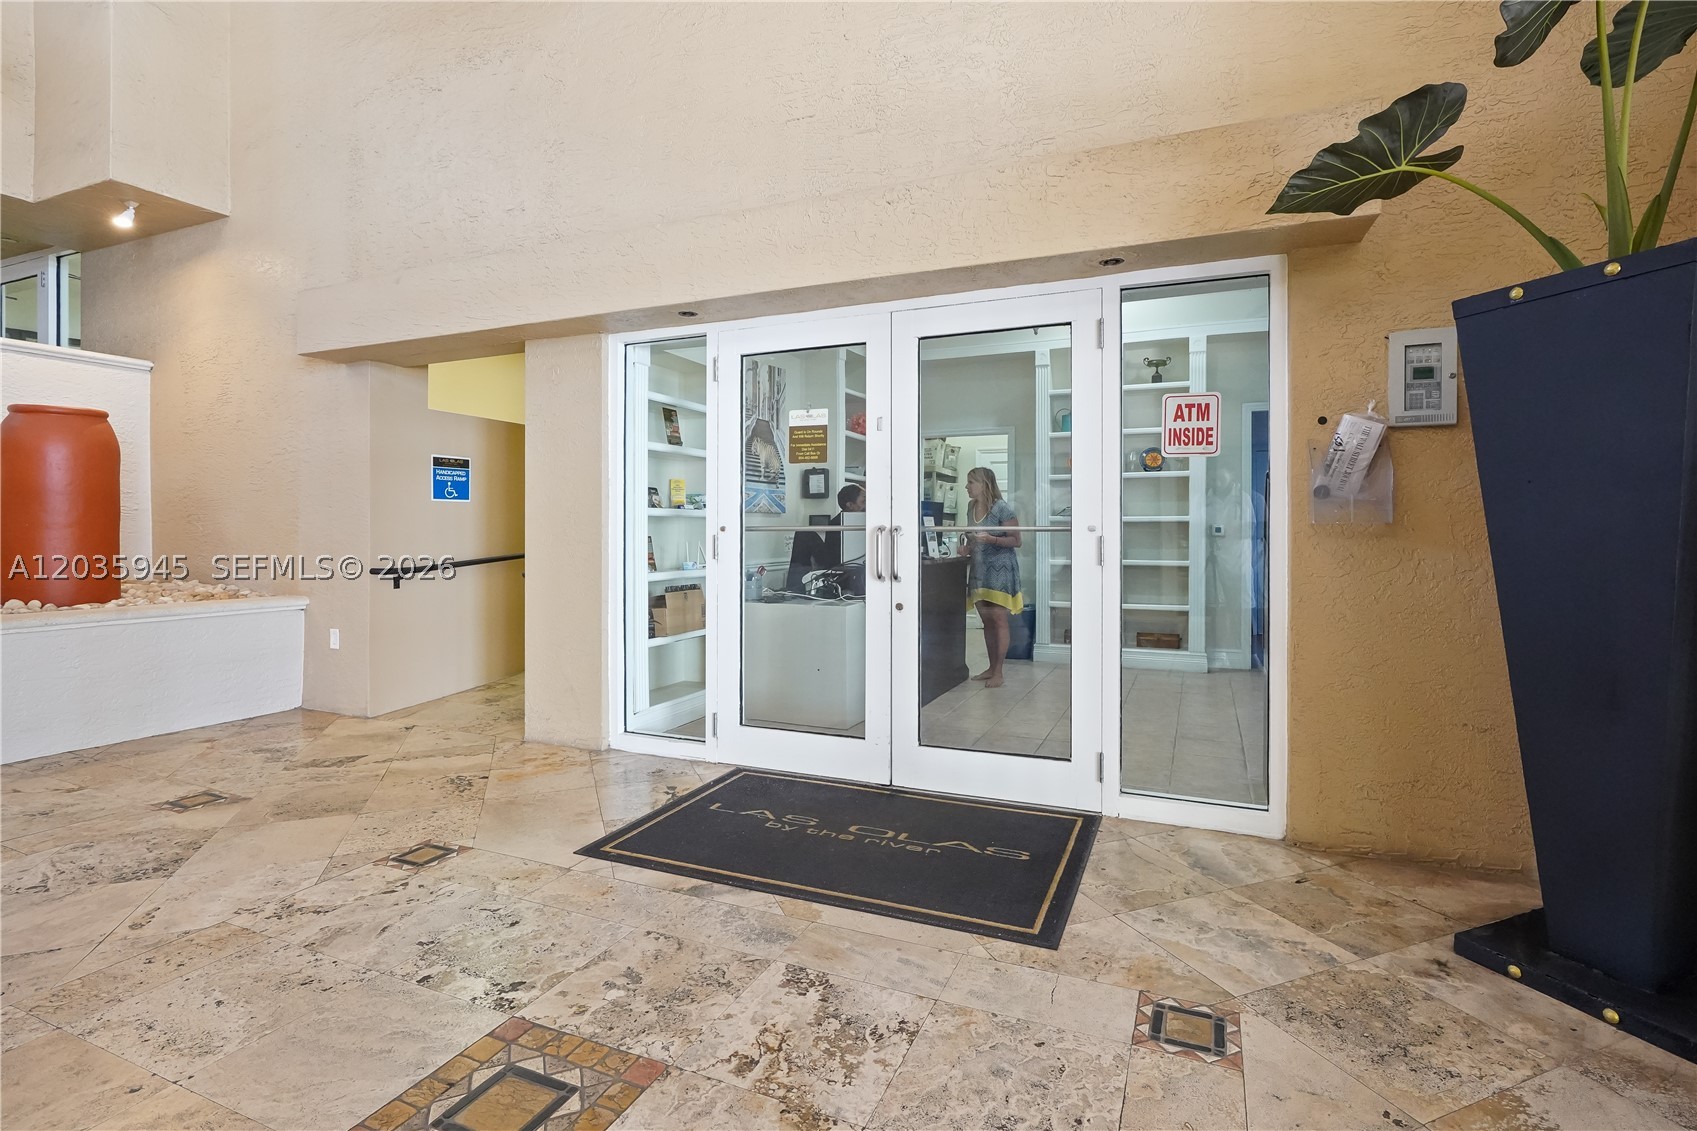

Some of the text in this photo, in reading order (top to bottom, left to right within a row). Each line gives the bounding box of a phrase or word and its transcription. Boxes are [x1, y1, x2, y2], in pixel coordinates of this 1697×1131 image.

[1173, 402, 1210, 422] ATM
[1168, 427, 1214, 446] INSIDE
[1361, 425, 1373, 438] THE
[1346, 450, 1360, 471] STREET
[709, 802, 1031, 861] LAS OLAS
[764, 820, 941, 855] by the river
